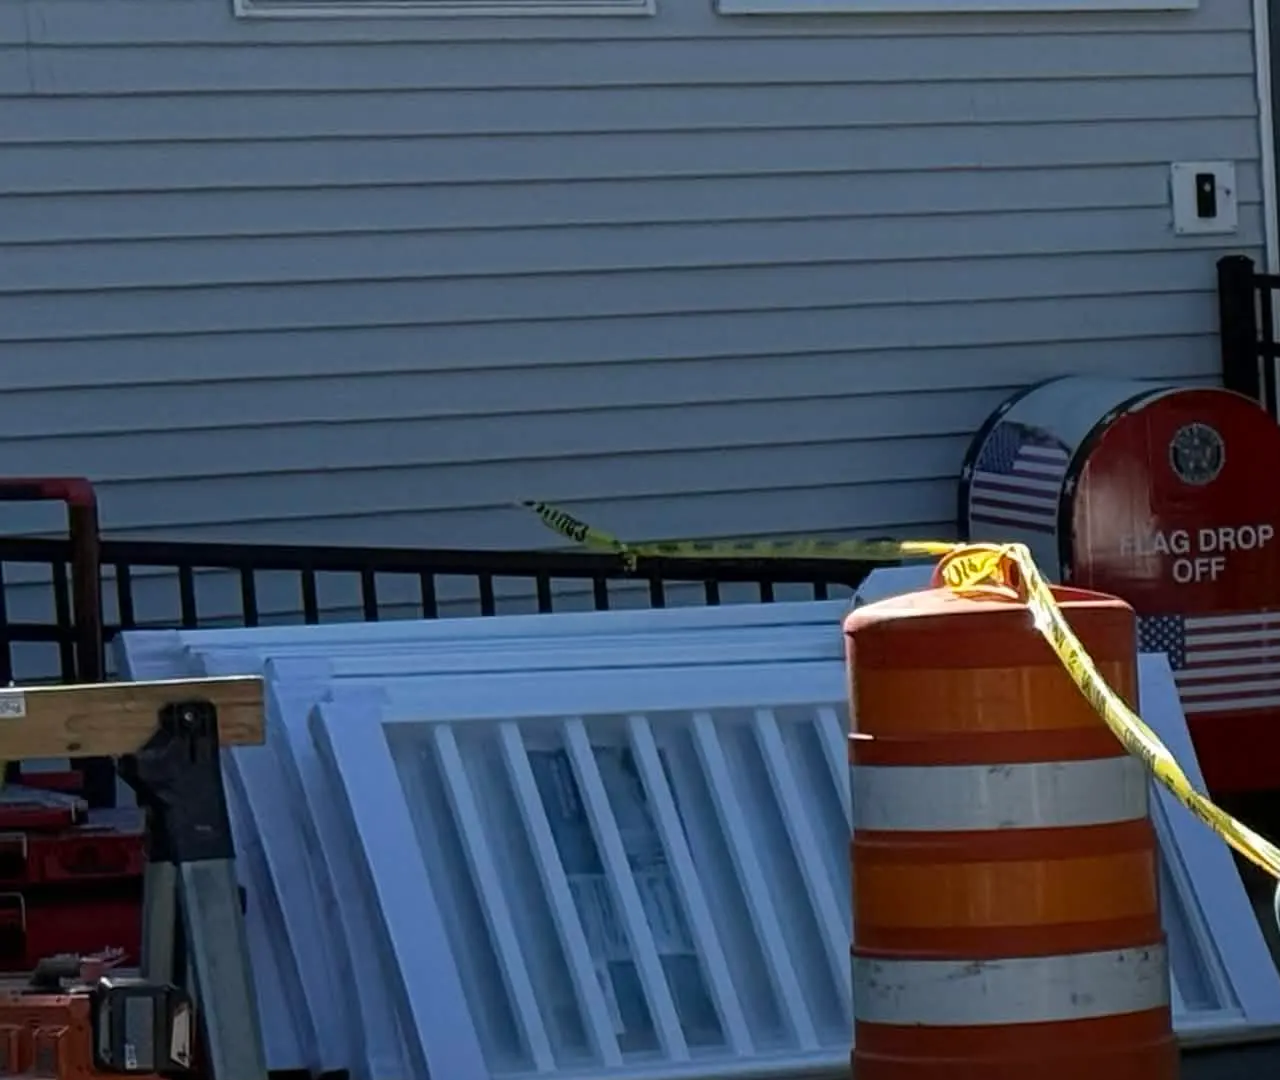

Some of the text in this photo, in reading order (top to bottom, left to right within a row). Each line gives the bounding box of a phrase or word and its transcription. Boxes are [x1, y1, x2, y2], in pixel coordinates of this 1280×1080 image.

[1119, 525, 1274, 557] FLAG DROP
[1172, 557, 1226, 583] OFF
